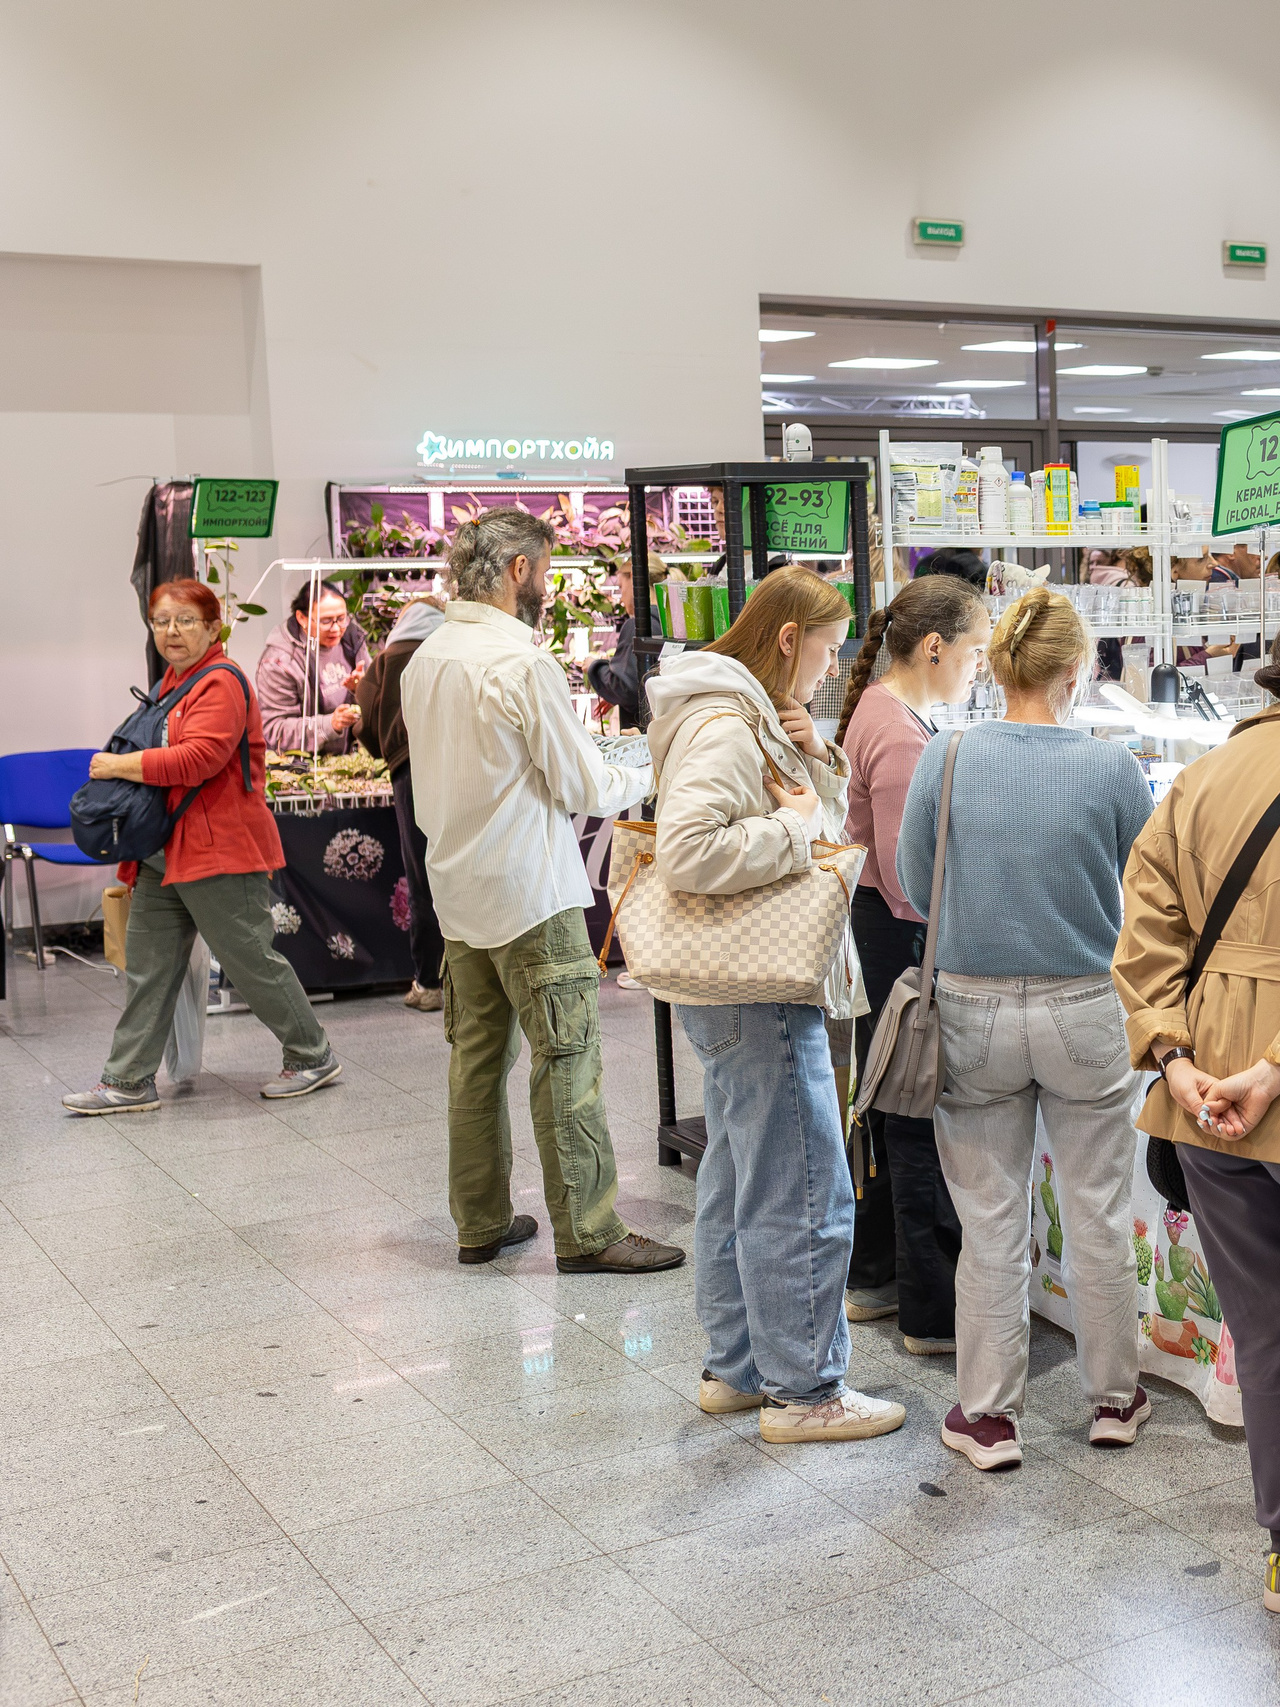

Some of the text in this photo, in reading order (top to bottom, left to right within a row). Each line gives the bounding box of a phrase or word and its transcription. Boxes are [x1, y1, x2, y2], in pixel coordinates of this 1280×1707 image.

[447, 436, 615, 461] ИМПОРТХОЙЯ
[215, 489, 266, 502] 122-123
[765, 486, 824, 508] 92-93
[203, 516, 268, 528] ИМПОРТХОЙЯ
[766, 519, 823, 535] СЁ ДЛЯ
[767, 535, 828, 549] СТЕНИЙ
